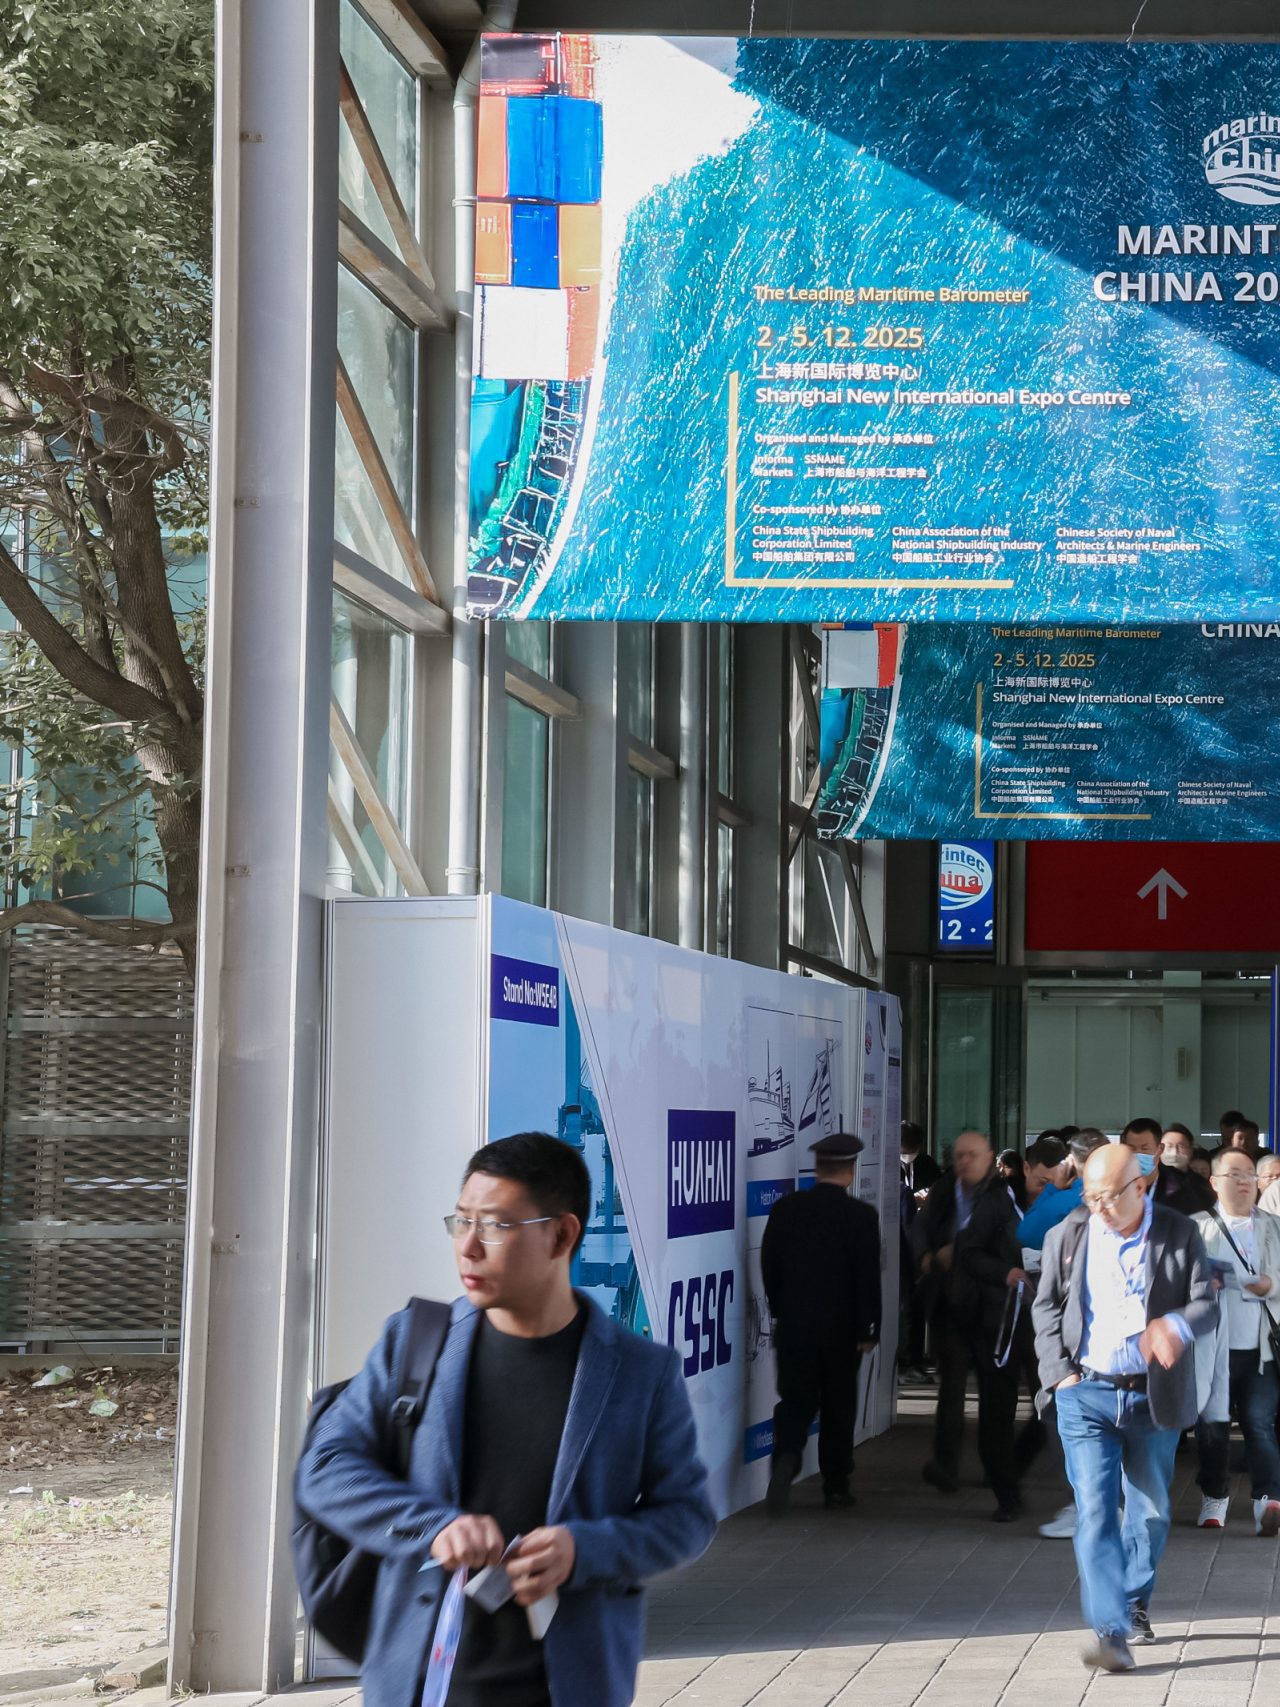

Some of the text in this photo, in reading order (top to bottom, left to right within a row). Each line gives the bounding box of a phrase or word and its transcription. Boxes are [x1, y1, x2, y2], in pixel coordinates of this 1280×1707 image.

[1094, 272, 1222, 302] CHINA
[754, 285, 1030, 305] The Leading Maritime Barometer
[757, 326, 772, 347] 2
[792, 327, 813, 348] 5.
[823, 327, 857, 348] 12.
[864, 327, 923, 348] 2025
[757, 362, 919, 381] 上海新国际博览中心
[755, 388, 1131, 408] Shanghai New International Expo Centre
[754, 434, 807, 445] Organised
[809, 434, 828, 444] and
[830, 434, 876, 445] Managed
[878, 434, 890, 445] by
[754, 455, 794, 464] Informa
[804, 455, 846, 464] SSNAME
[753, 468, 794, 477] Markets
[753, 505, 824, 515] Co-sponsored
[825, 505, 837, 515] by
[753, 526, 874, 538] China State Shipbuilding
[892, 527, 1010, 537] China Association of the
[1056, 528, 1175, 539] Chinese Society of Naval
[752, 540, 852, 551] Corporation Limited
[892, 540, 1043, 551] National Shipbuilding Industry
[1056, 541, 1201, 553] Architects & Marine Engineers
[992, 627, 1161, 639] The Leading Maritime Barometer
[993, 653, 1002, 666] 2
[1060, 654, 1096, 667] 2025
[993, 676, 1092, 688] 上海新国际博览中心
[992, 692, 1224, 706] Shanghai New International Expo Centre
[942, 847, 985, 873] intec
[503, 975, 523, 1004] Stand
[671, 1140, 732, 1207] HUAHAI
[667, 1269, 734, 1378] CSSC
